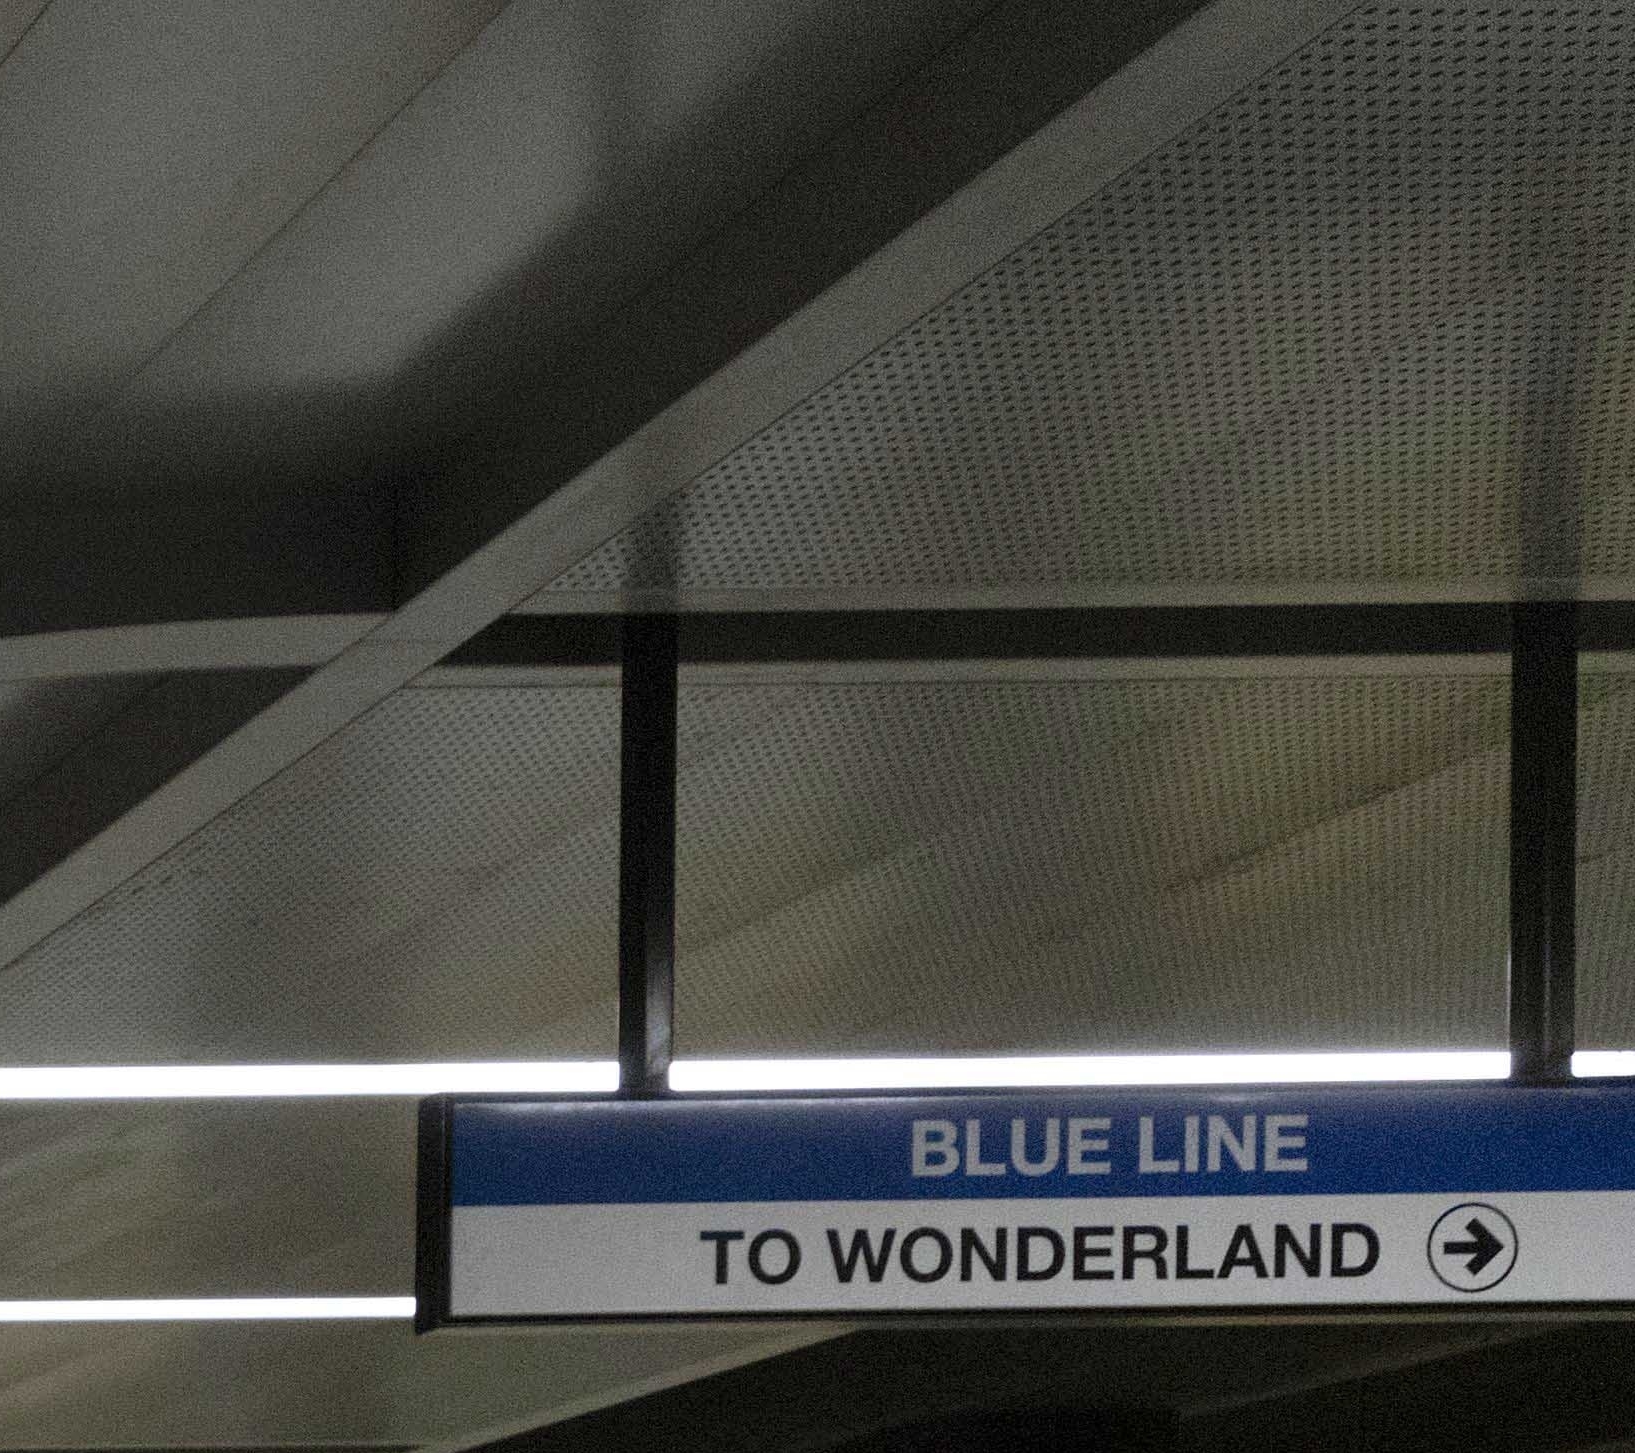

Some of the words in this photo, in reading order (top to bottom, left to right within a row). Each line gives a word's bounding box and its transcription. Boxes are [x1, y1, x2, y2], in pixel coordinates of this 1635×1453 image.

[912, 1118, 1111, 1176] BLUE
[1139, 1114, 1308, 1173] LINE
[699, 1228, 802, 1286] TO
[825, 1222, 1380, 1284] WONDERLAND
